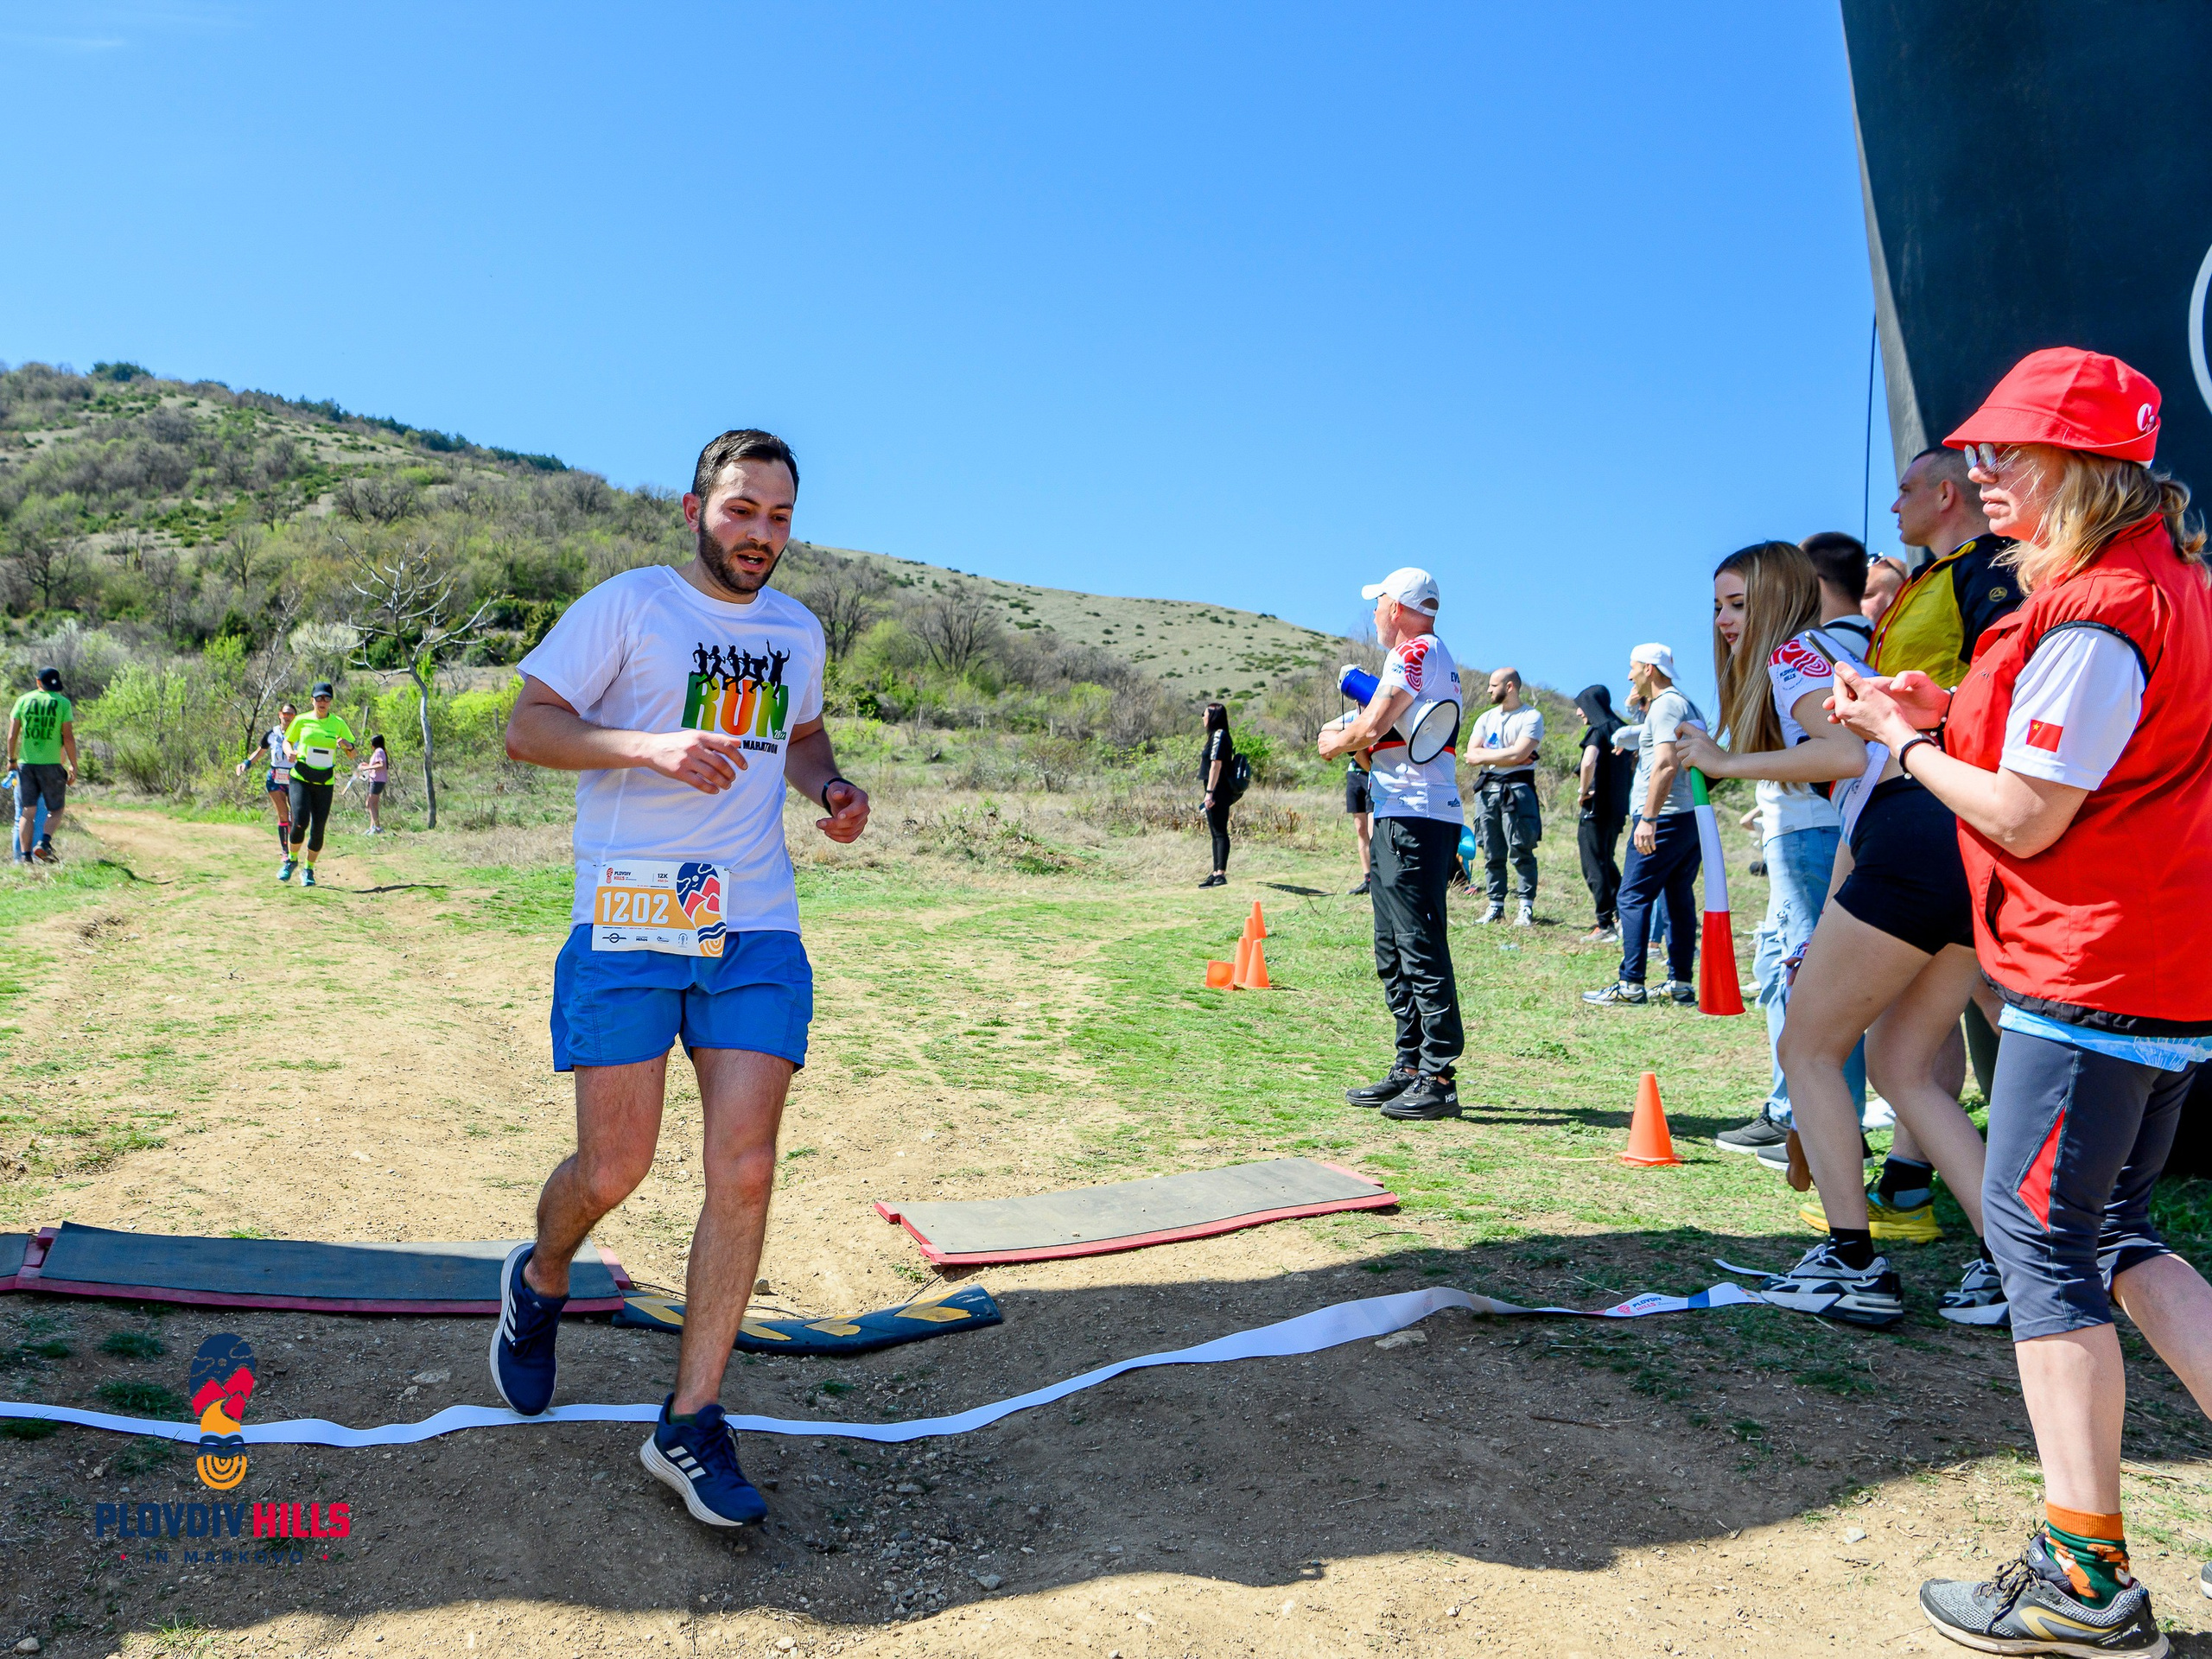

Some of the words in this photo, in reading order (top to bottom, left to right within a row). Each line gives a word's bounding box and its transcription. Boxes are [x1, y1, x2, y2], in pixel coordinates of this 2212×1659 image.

[25, 698, 58, 716] AIR
[681, 671, 788, 738] RUN
[24, 727, 54, 741] SOLE
[743, 740, 778, 754] MARATHON
[601, 891, 669, 925] 1202
[1632, 1296, 1662, 1307] PLOVDIV
